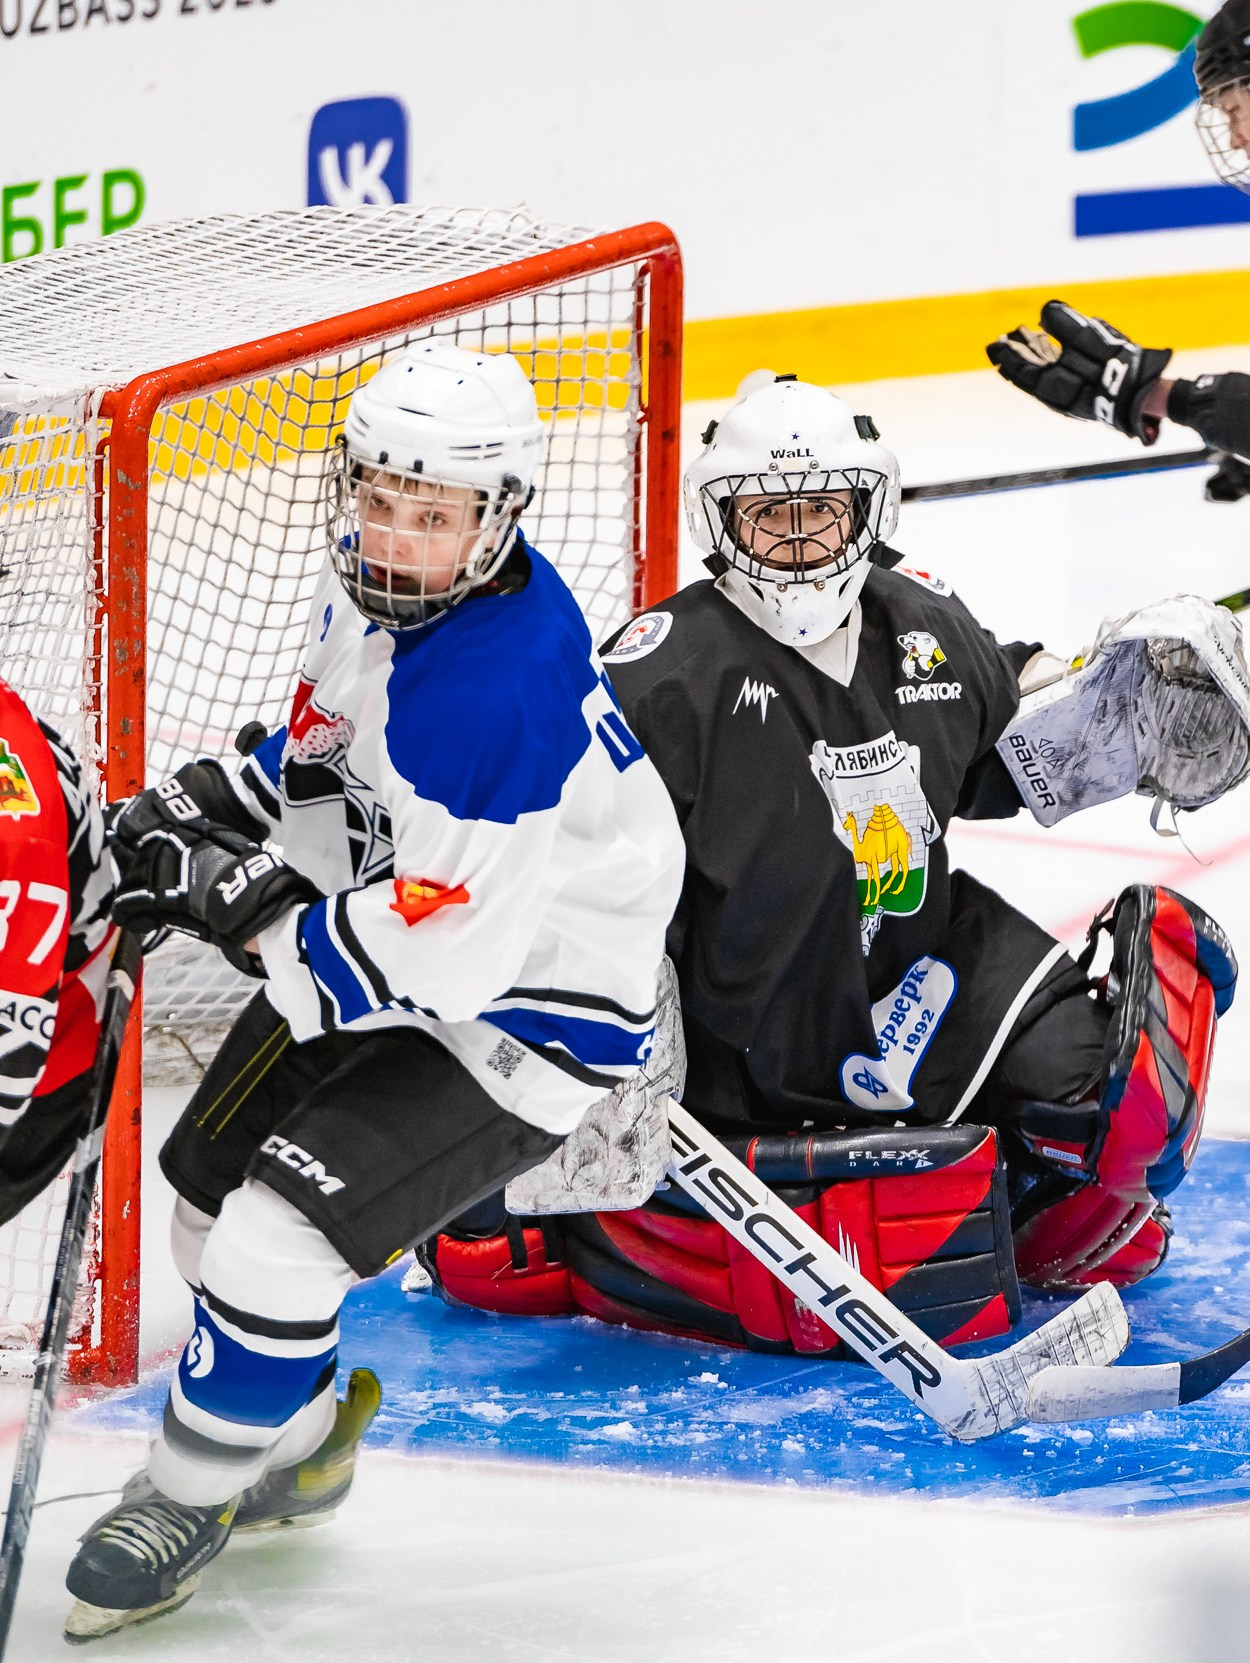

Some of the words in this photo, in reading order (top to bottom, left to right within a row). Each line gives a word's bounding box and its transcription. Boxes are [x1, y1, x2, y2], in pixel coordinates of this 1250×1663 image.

[895, 681, 963, 705] TRAKTOR
[825, 739, 902, 772] ЛЯБИНС
[903, 1008, 936, 1055] 1992
[260, 1134, 346, 1196] CCM
